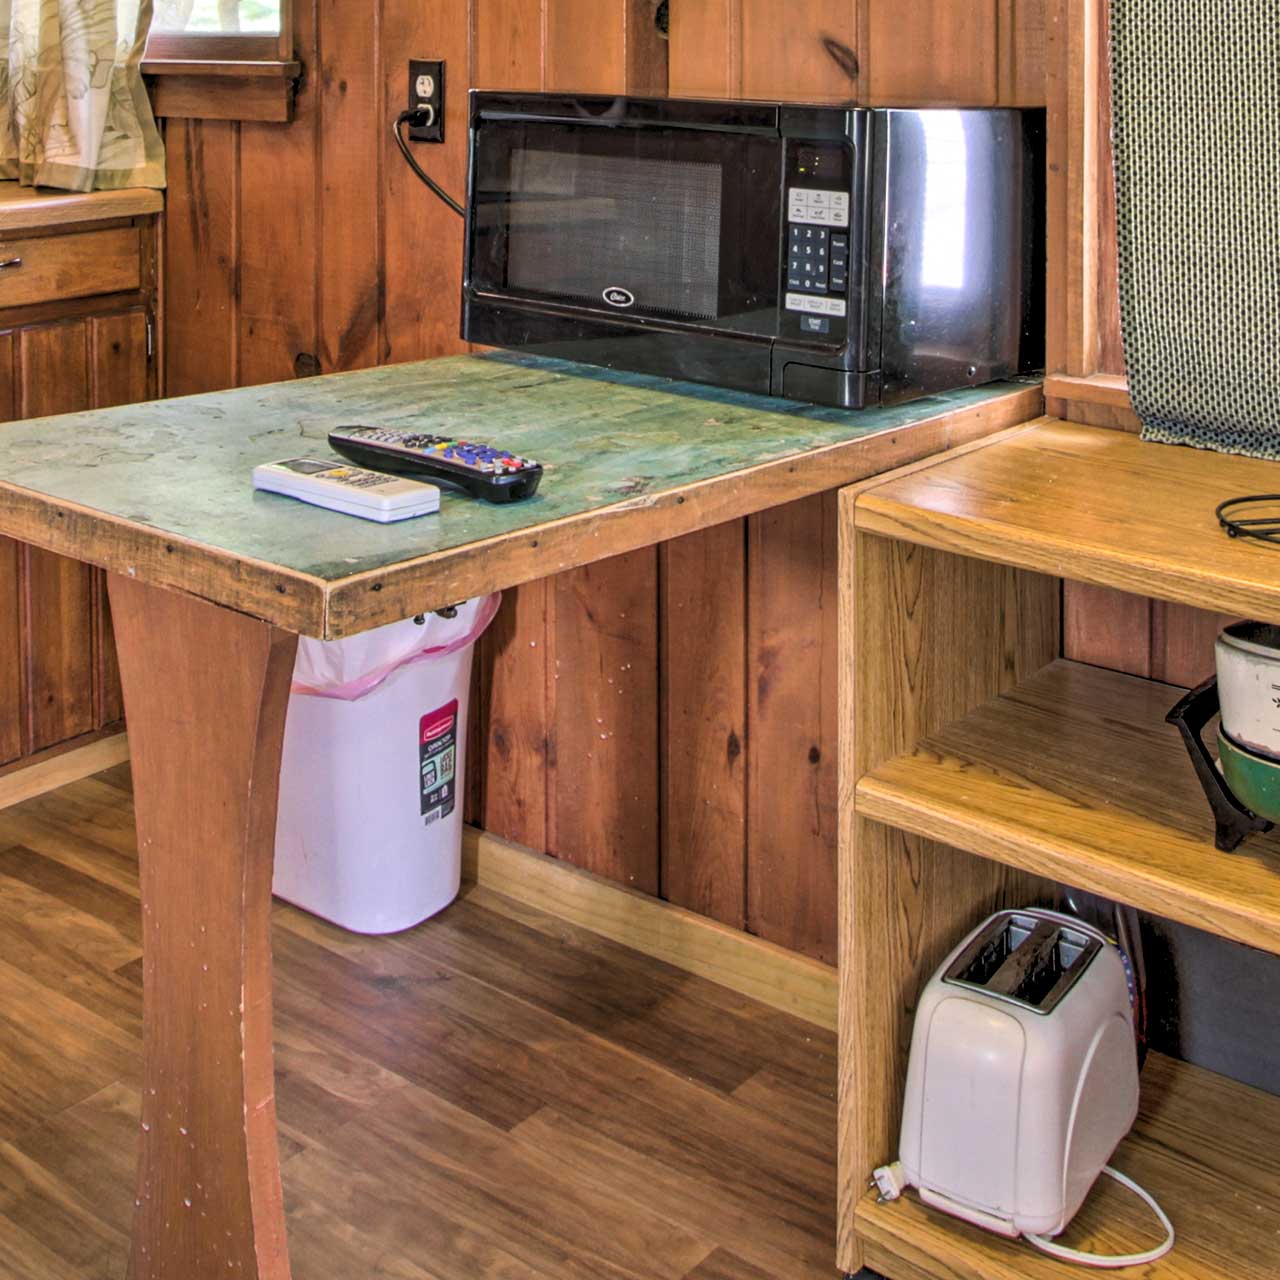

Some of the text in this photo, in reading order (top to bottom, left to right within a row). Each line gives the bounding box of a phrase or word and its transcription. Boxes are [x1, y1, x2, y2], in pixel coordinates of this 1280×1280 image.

[793, 228, 825, 239] 1 2 3
[792, 245, 825, 256] 4 5 6
[805, 263, 811, 271] 8
[805, 280, 811, 288] 0
